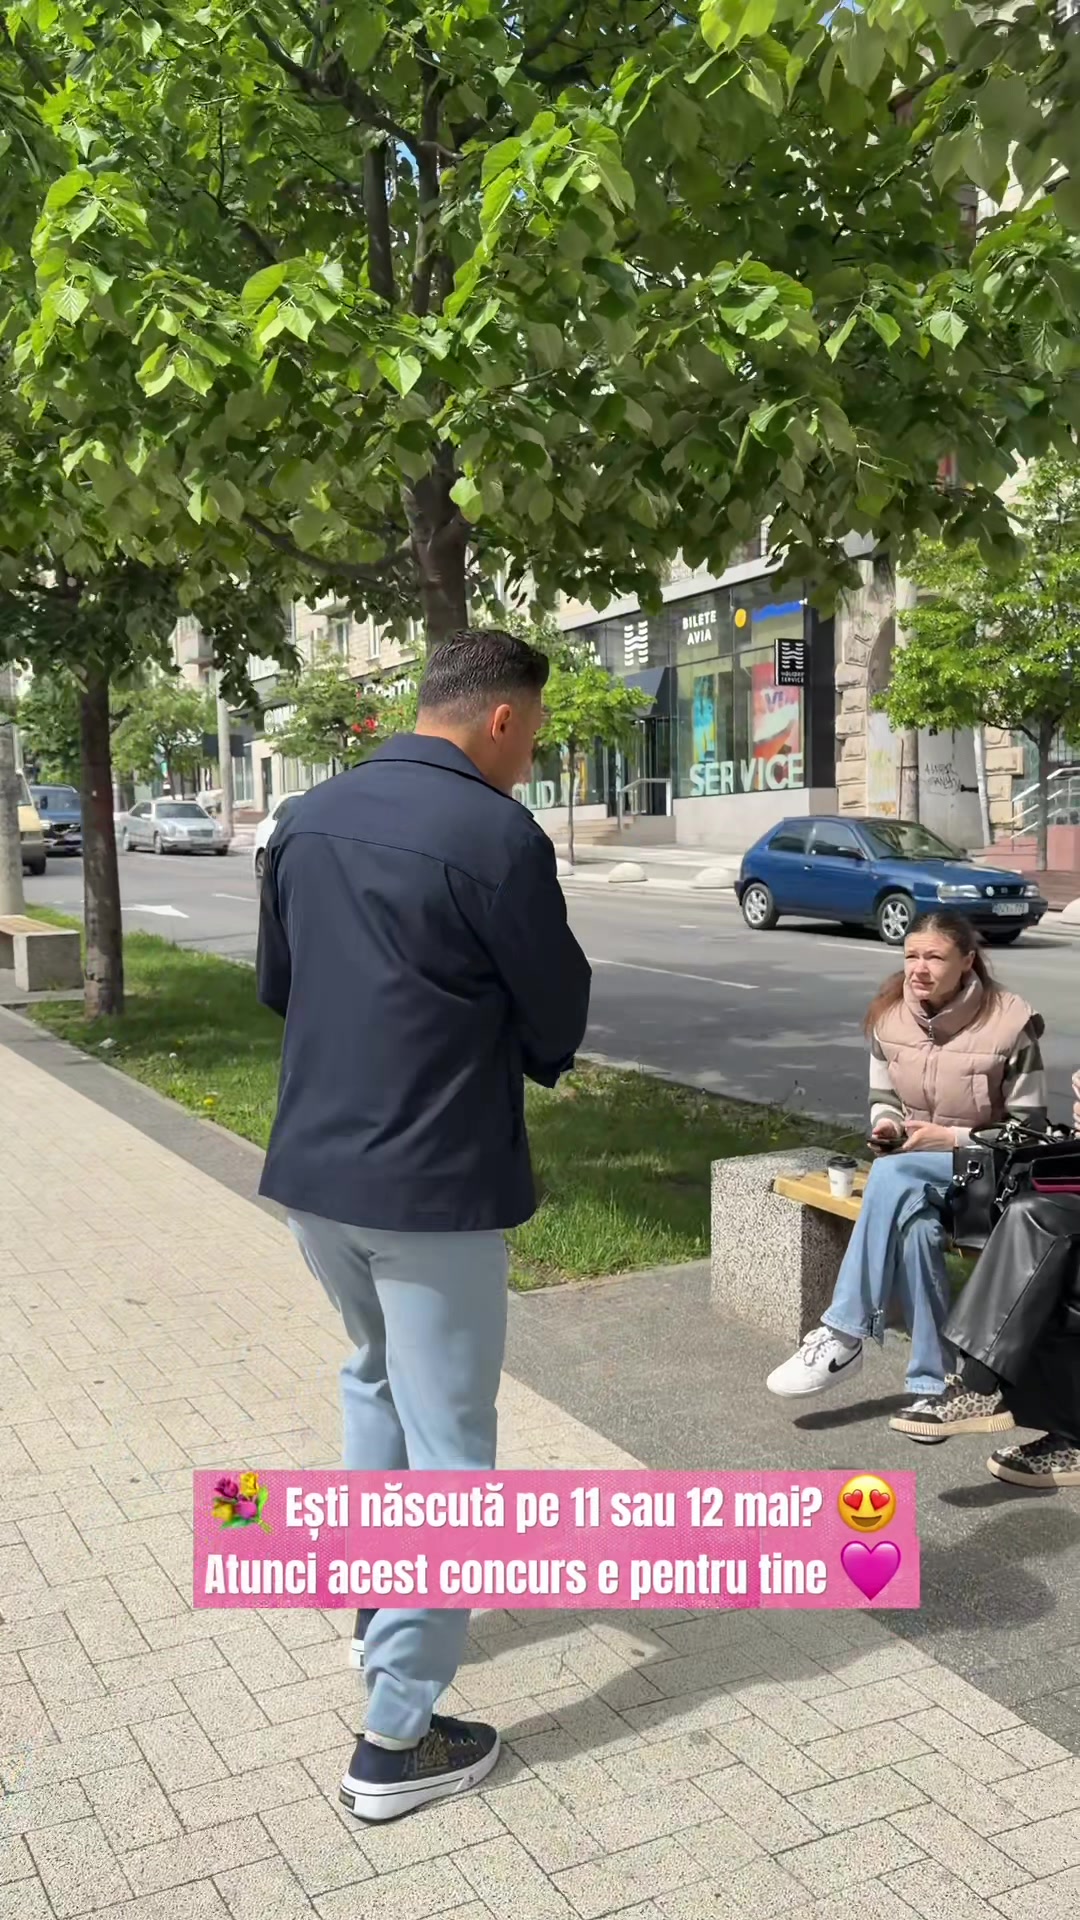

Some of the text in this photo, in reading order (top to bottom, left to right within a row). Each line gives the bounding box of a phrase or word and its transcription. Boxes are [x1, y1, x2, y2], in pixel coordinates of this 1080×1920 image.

[682, 610, 717, 630] BILETE
[687, 629, 712, 645] AVIA
[689, 752, 804, 796] SERVICE
